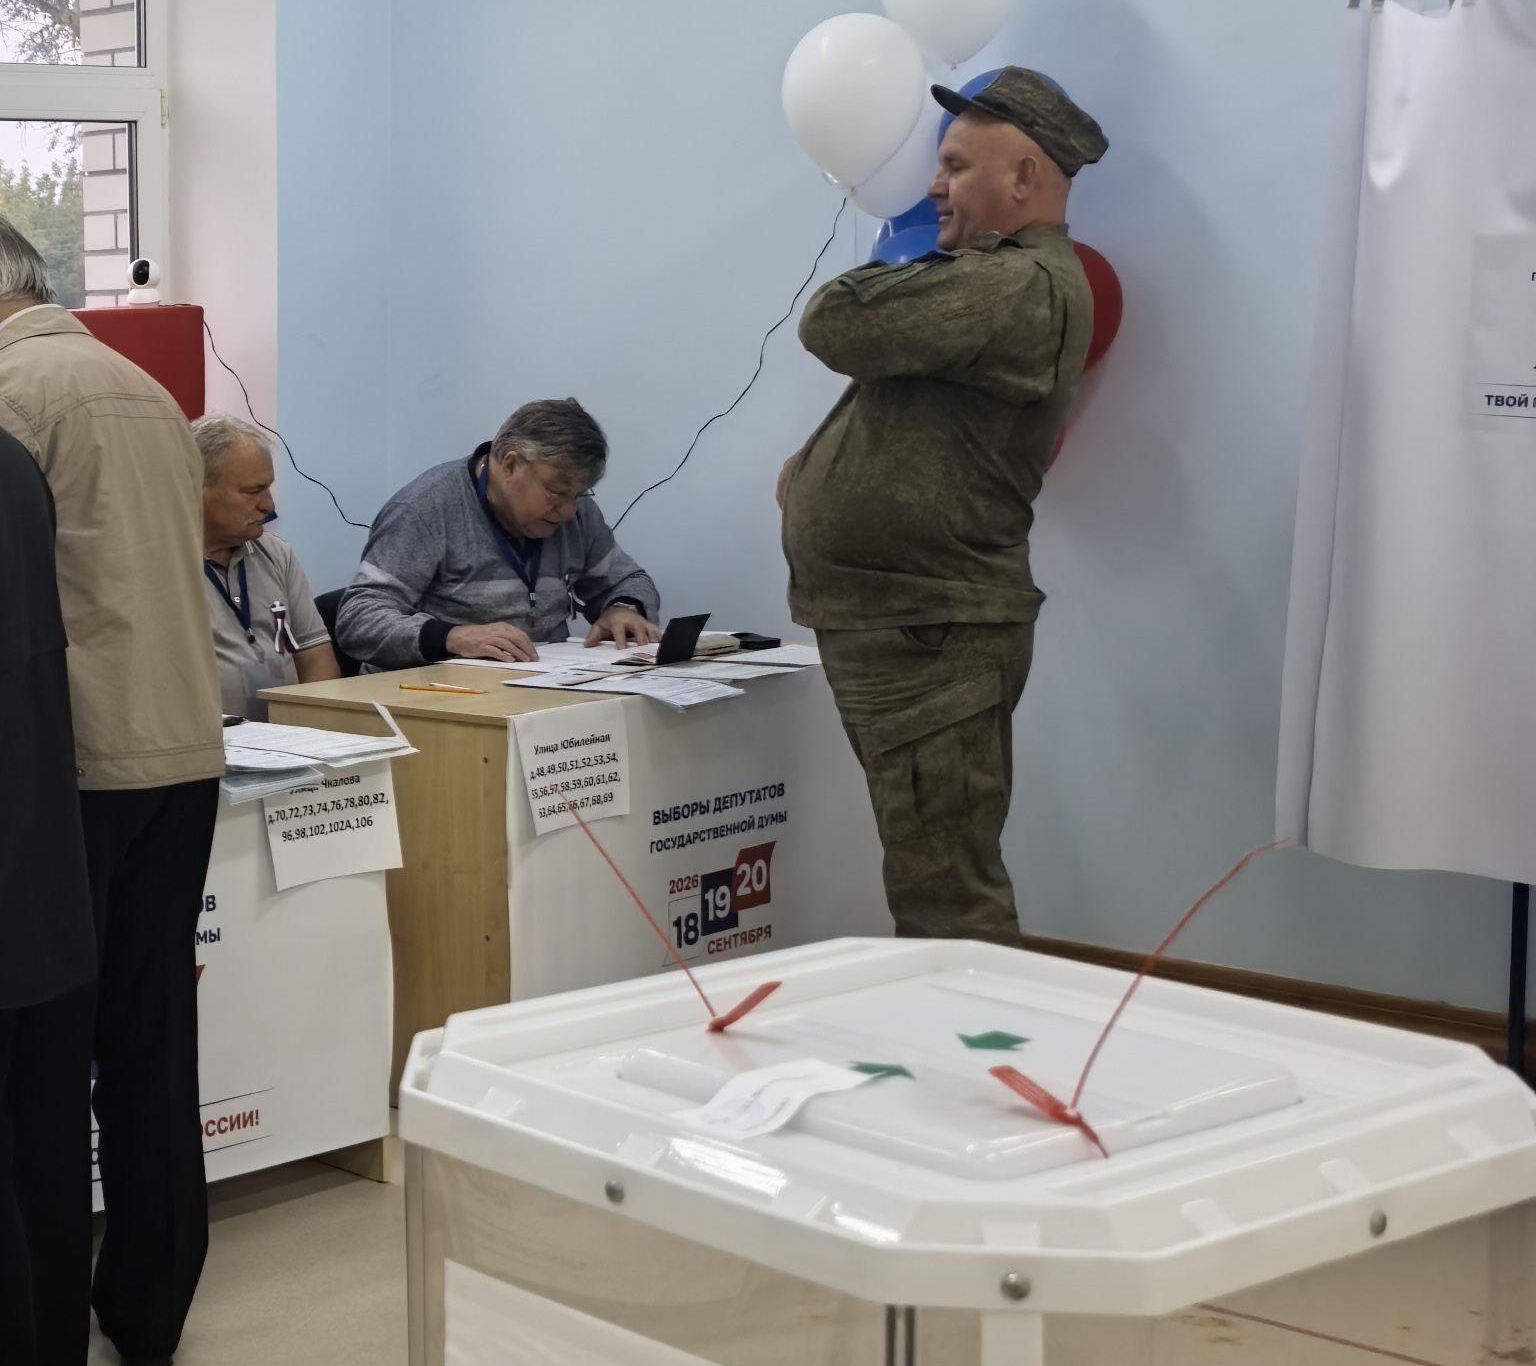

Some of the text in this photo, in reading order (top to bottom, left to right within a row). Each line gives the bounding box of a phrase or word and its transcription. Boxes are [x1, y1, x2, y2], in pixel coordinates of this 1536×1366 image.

[1484, 393, 1529, 408] ТВОЙ
[533, 733, 611, 756] Улица Юбилейная
[321, 775, 361, 789] Чкалова
[652, 782, 785, 826] ВЫБОРЫ ДЕПУТАТОВ
[650, 809, 788, 854] ГОСУДАРСТВЕННОЙ ДУМЫ
[668, 874, 699, 895] 2026
[672, 858, 768, 949] 18 19 20
[707, 924, 772, 955] СЕНТЯБРЯ
[200, 1109, 259, 1137] ССИИ!
